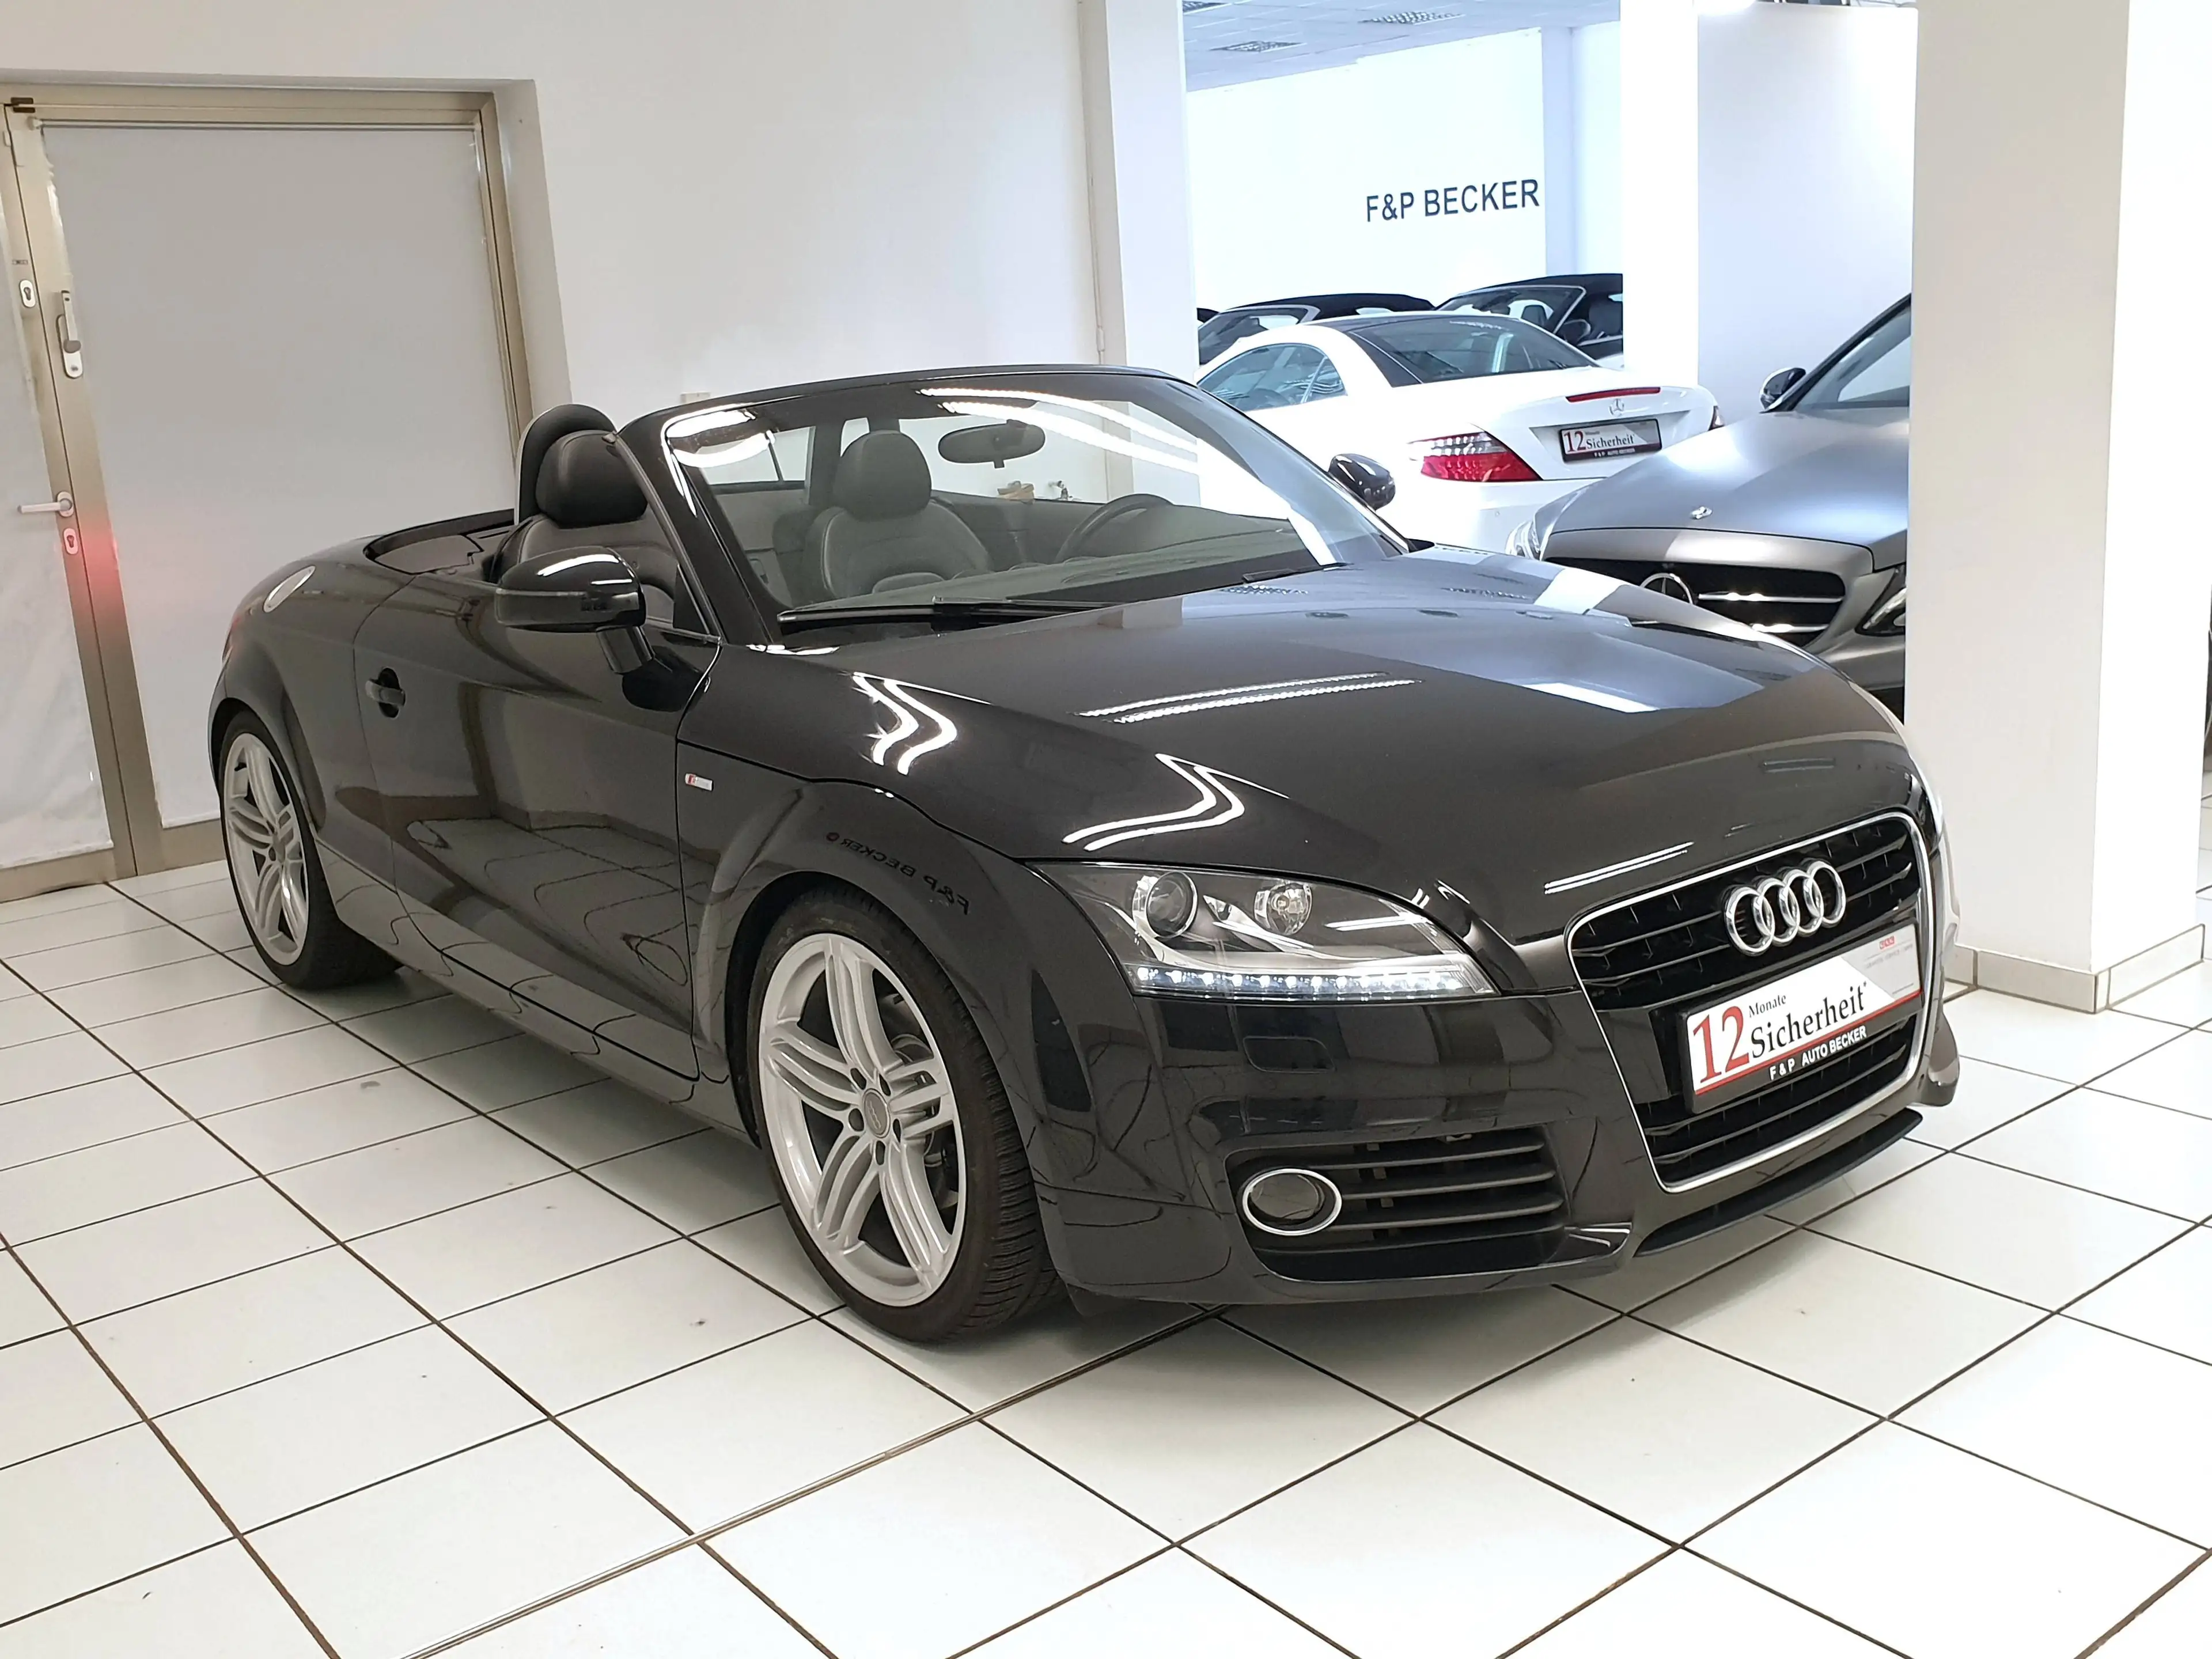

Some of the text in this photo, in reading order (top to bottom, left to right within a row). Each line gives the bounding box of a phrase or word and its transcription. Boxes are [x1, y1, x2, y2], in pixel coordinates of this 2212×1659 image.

[1366, 179, 1540, 222] F&P BECKER
[1563, 430, 1586, 453] 12
[1748, 994, 1787, 1018] Monate
[1692, 1005, 1750, 1084] 12
[1770, 1066, 1777, 1081] F
[1787, 1058, 1796, 1073] P
[1801, 1044, 1828, 1067] AUTO
[1830, 1025, 1867, 1054] BECKER
